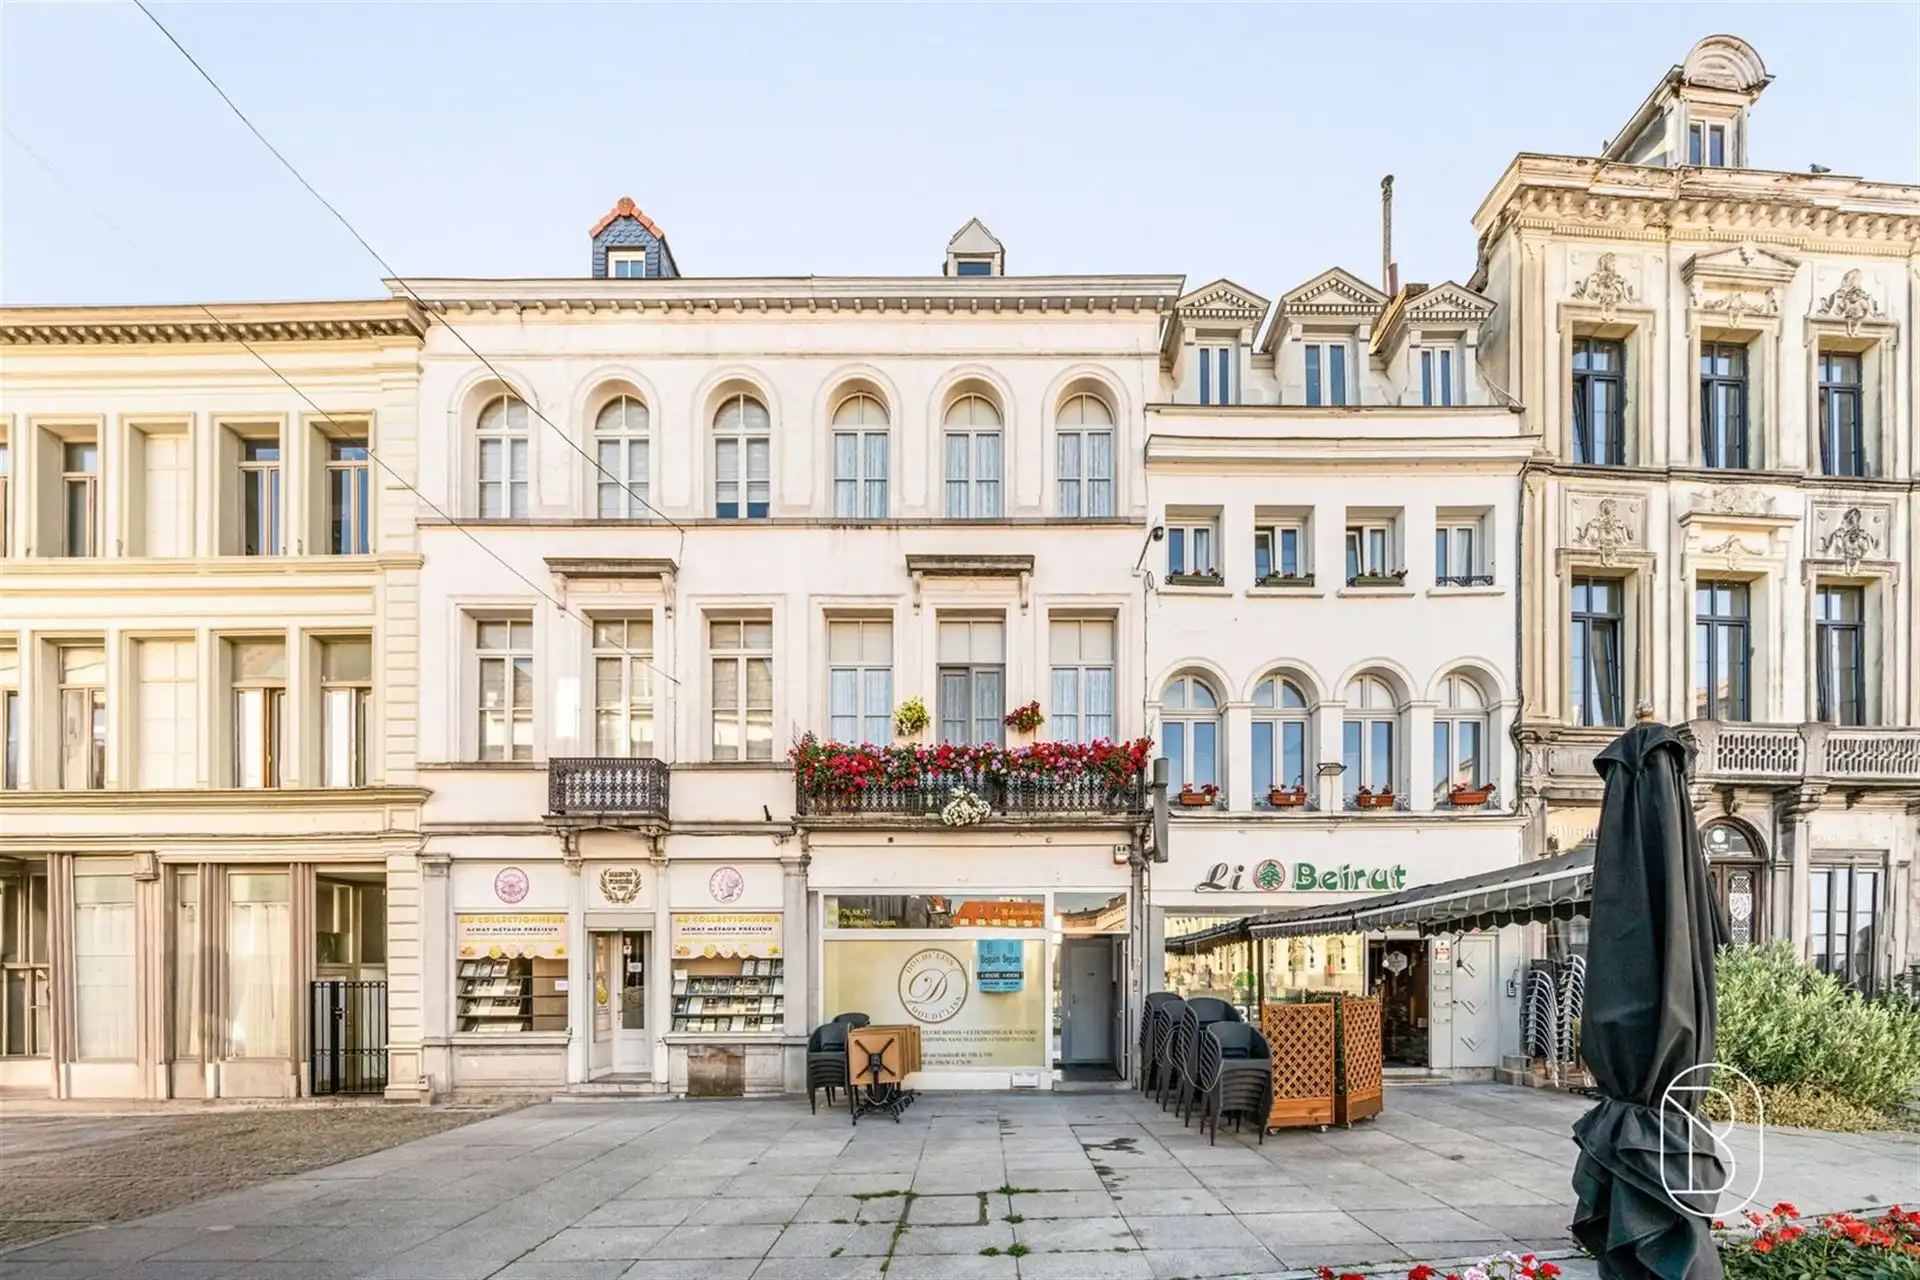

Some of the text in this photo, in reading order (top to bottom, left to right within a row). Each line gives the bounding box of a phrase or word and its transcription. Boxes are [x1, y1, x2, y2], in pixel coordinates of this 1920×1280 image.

[1196, 861, 1408, 892] Li Beirut
[477, 915, 565, 924] COLLECTIONNEUR
[692, 914, 781, 924] COLLECTIONNEUR
